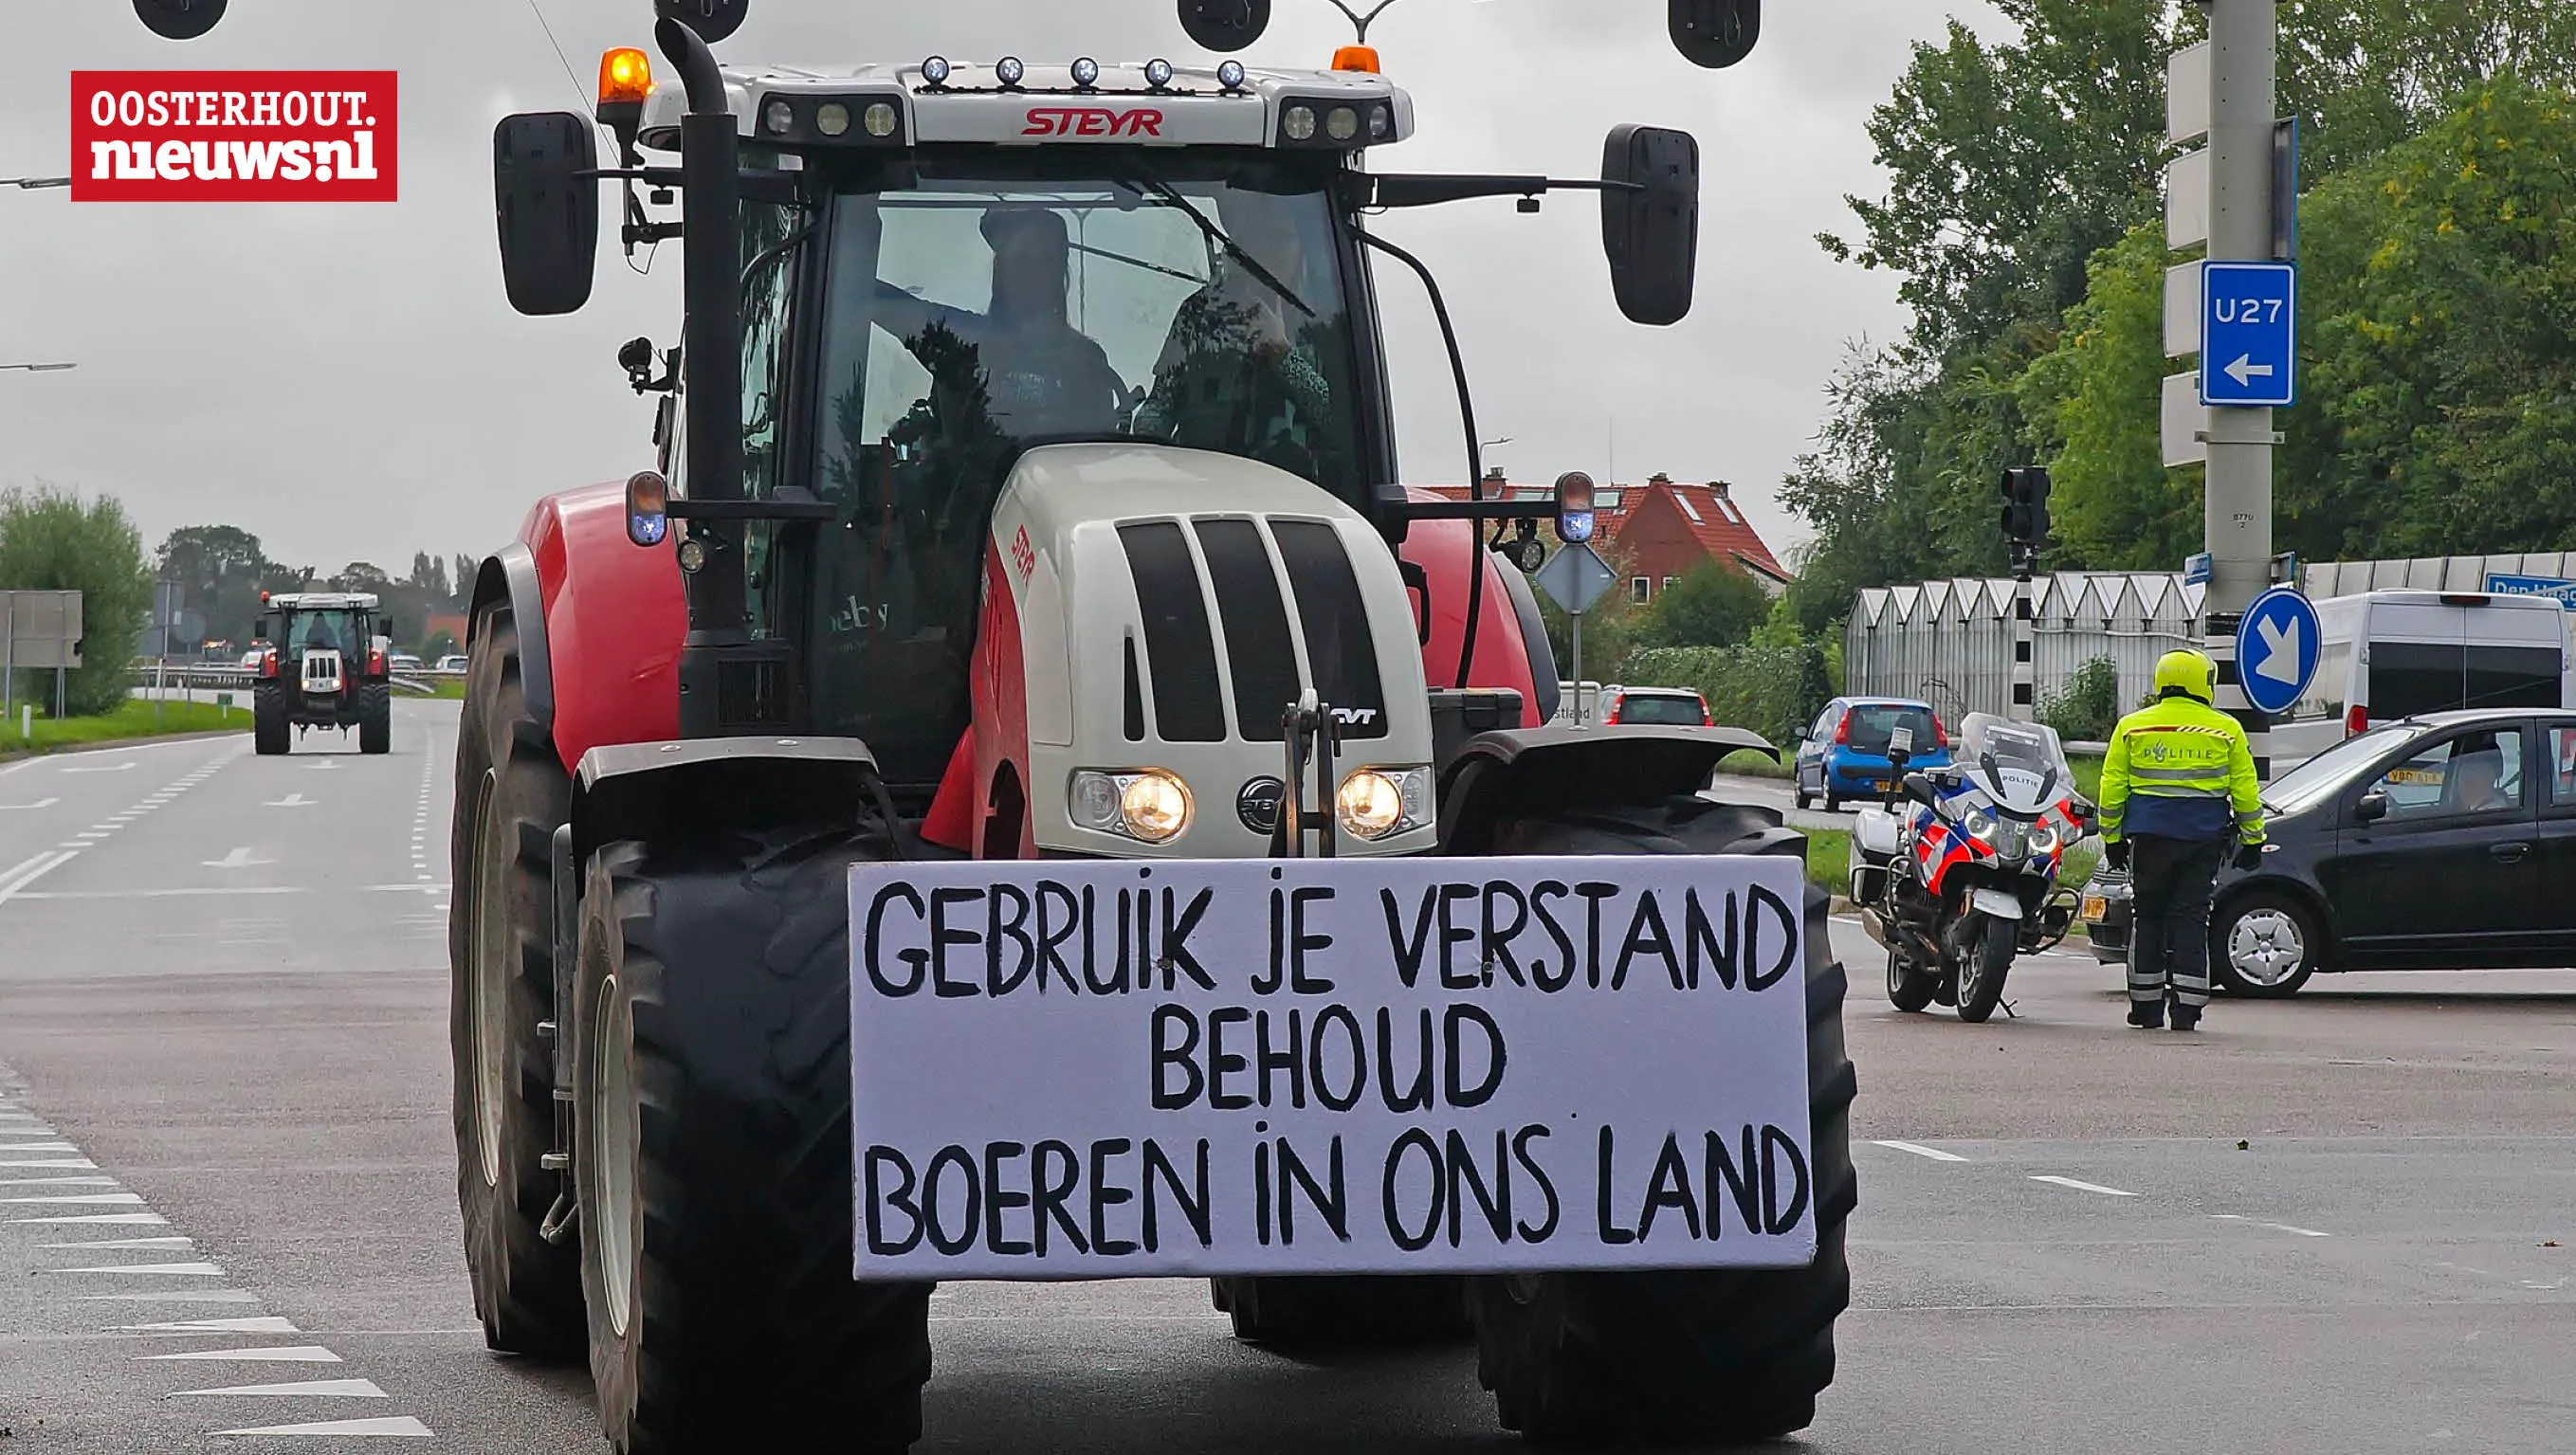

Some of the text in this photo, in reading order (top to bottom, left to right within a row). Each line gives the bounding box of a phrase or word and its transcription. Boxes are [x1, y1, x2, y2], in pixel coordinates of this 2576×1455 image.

[1021, 108, 1163, 136] STEYR
[2216, 299, 2282, 323] U27
[1010, 523, 1035, 588] STEYR
[2001, 774, 2038, 788] POLITIE
[1379, 880, 1799, 994] VERSTAND
[1151, 1003, 1507, 1114] BEHOUD
[864, 1137, 1213, 1259] BOEREN
[1382, 1123, 1561, 1252] ONS
[1597, 1122, 1810, 1246] LAND
